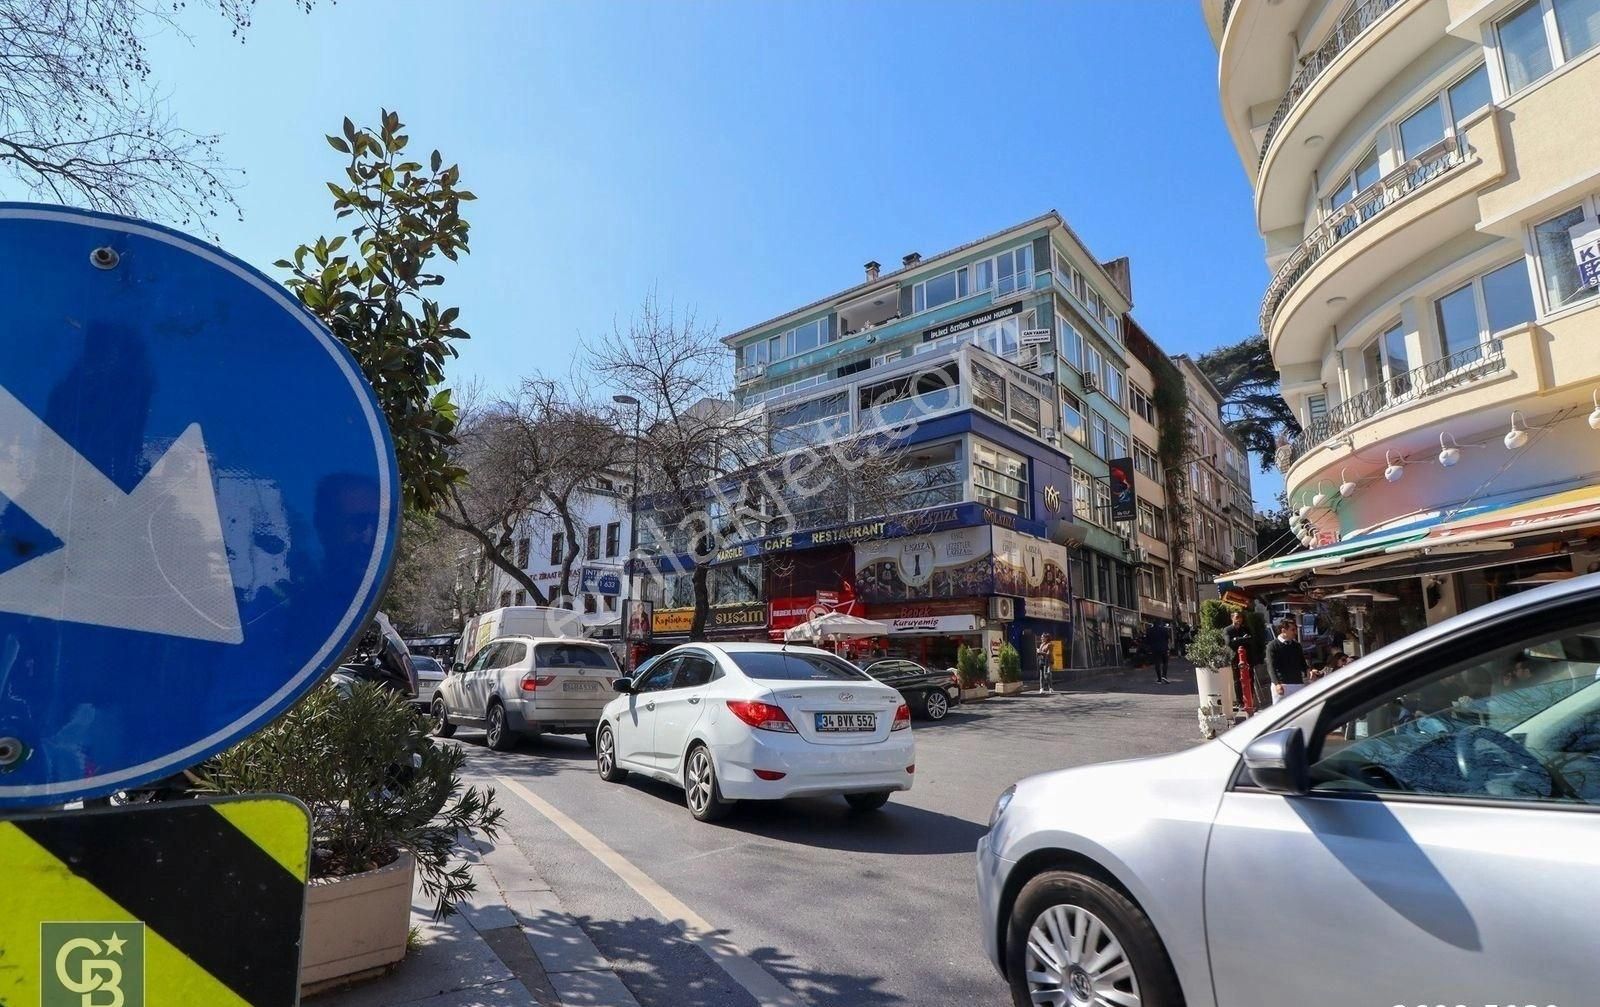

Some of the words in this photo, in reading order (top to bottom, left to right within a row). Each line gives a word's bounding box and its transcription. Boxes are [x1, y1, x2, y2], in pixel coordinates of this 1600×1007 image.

[949, 321, 970, 333] ÖZTÜRK
[971, 314, 992, 326] YAMAN
[993, 307, 1014, 320] HUKUK
[764, 536, 793, 551] CAFE
[811, 522, 886, 544] RESTAURANT
[715, 610, 764, 625] susam
[893, 617, 939, 627] Kuruyemiş
[822, 715, 834, 728] 34
[837, 715, 855, 727] BVK
[857, 715, 873, 727] 552
